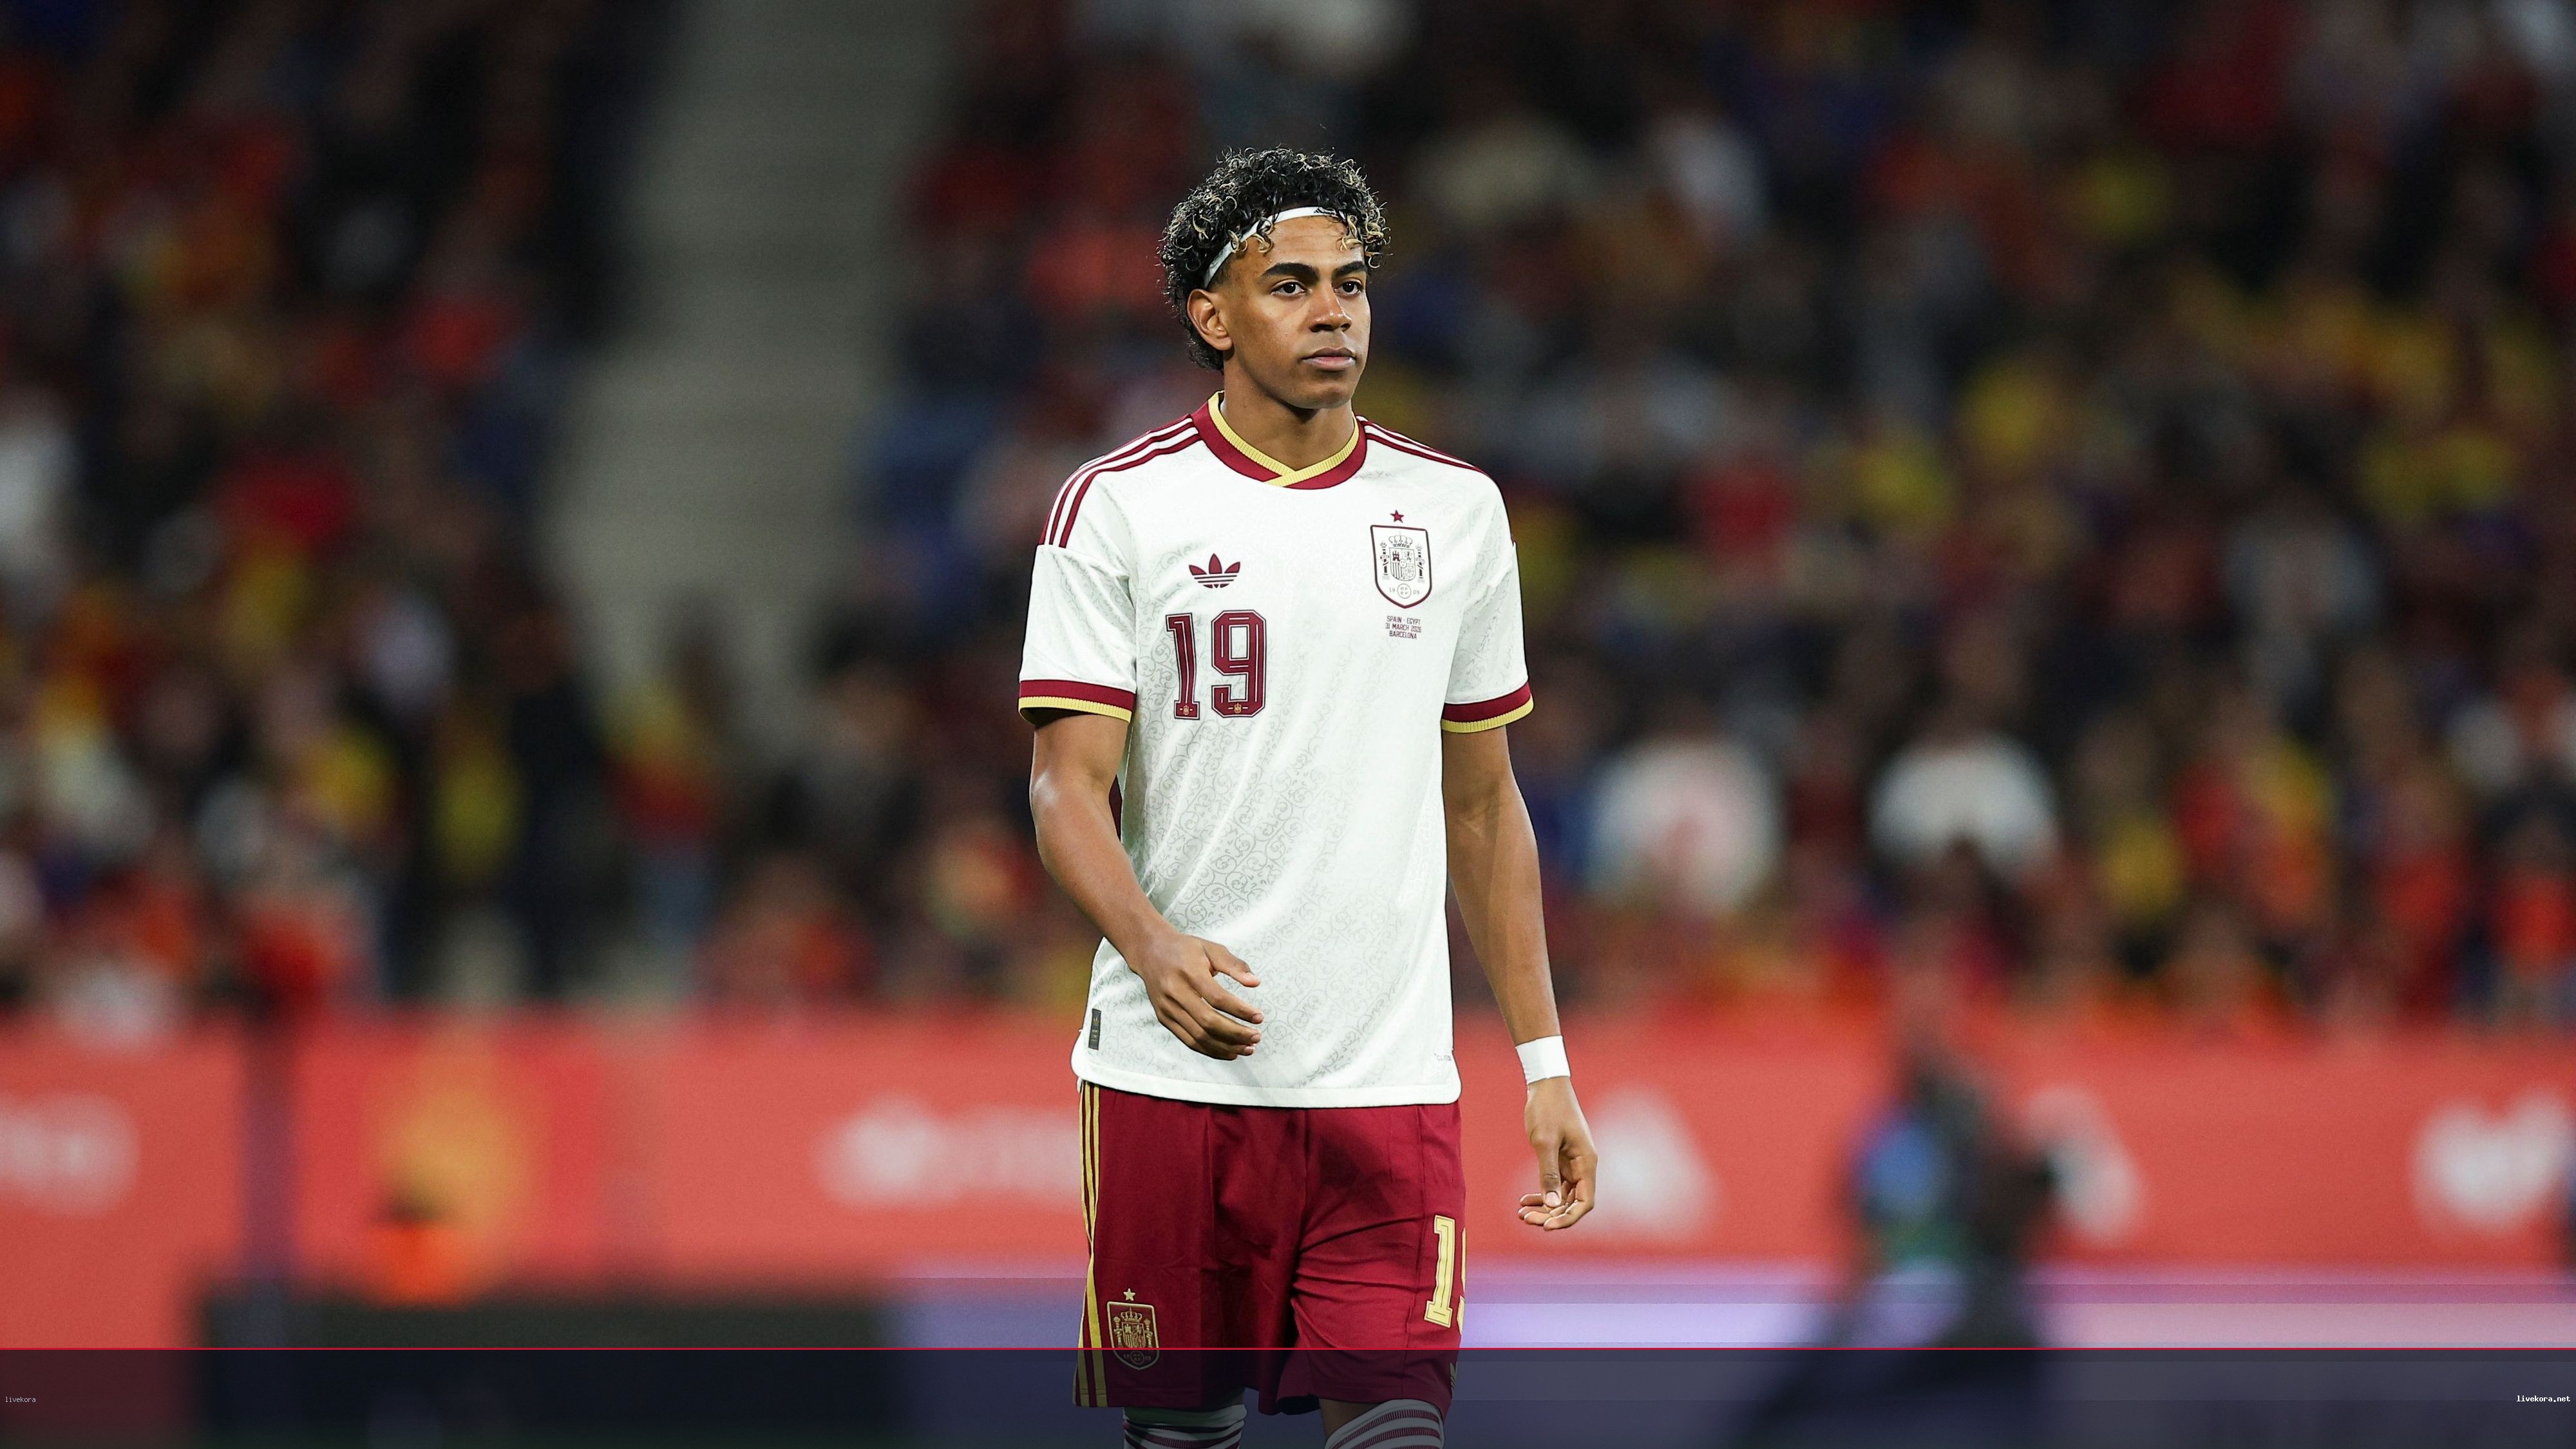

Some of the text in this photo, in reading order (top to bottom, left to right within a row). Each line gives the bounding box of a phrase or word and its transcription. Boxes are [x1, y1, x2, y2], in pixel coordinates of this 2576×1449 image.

[1165, 609, 1267, 721] 19
[1389, 630, 1417, 639] BARCELONA
[1424, 1215, 1466, 1335] 1
